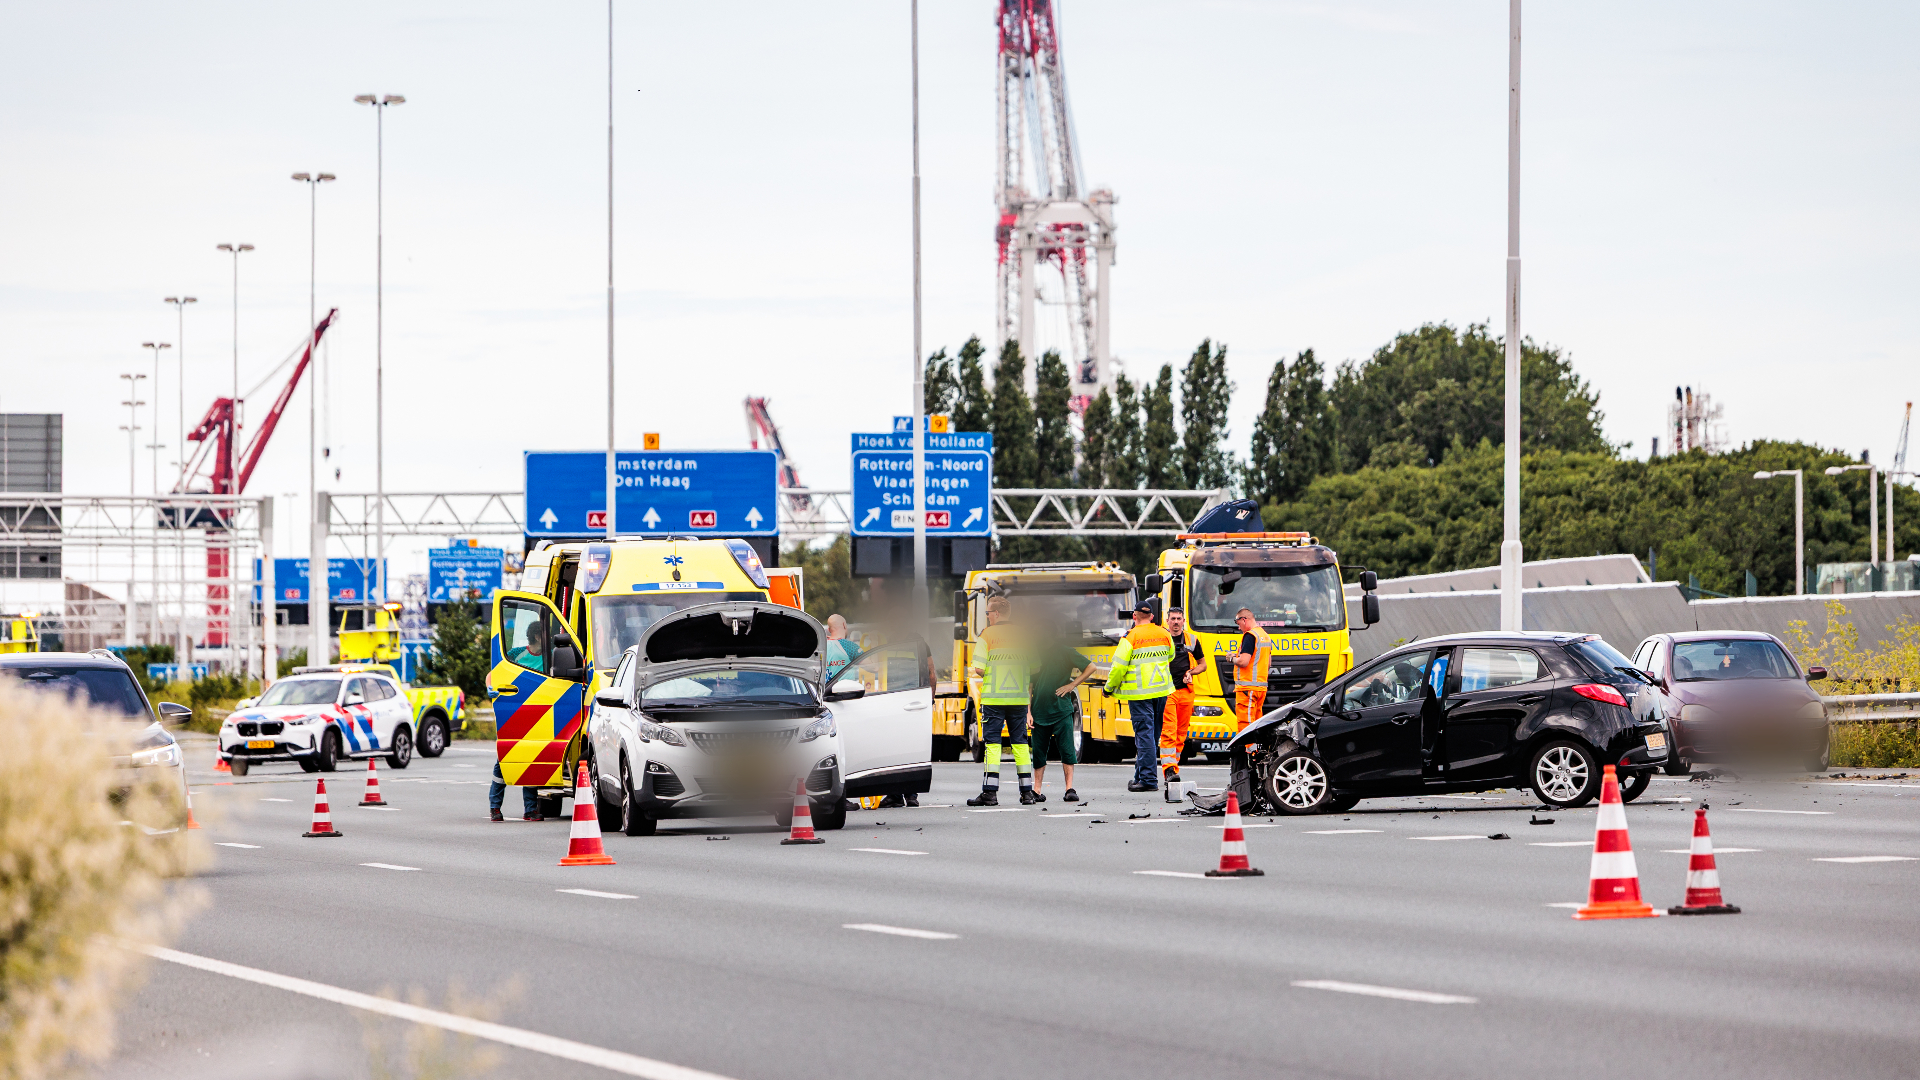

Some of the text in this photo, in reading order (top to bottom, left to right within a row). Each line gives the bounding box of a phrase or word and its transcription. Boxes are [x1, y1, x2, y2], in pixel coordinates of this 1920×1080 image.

[934, 418, 943, 430] 9
[646, 435, 656, 446] 9
[858, 435, 985, 448] Hoek va Holland
[605, 457, 698, 471] msterdam
[859, 457, 984, 472] Rotterdm-Noord
[615, 474, 690, 491] Den Haag
[872, 475, 970, 492] Vlaaringen
[882, 492, 960, 506] Schdam
[692, 513, 714, 526] A4
[893, 515, 915, 523] RIN
[926, 513, 948, 526] A4
[1229, 638, 1328, 652] BNDREGT
[1268, 666, 1292, 675] AF
